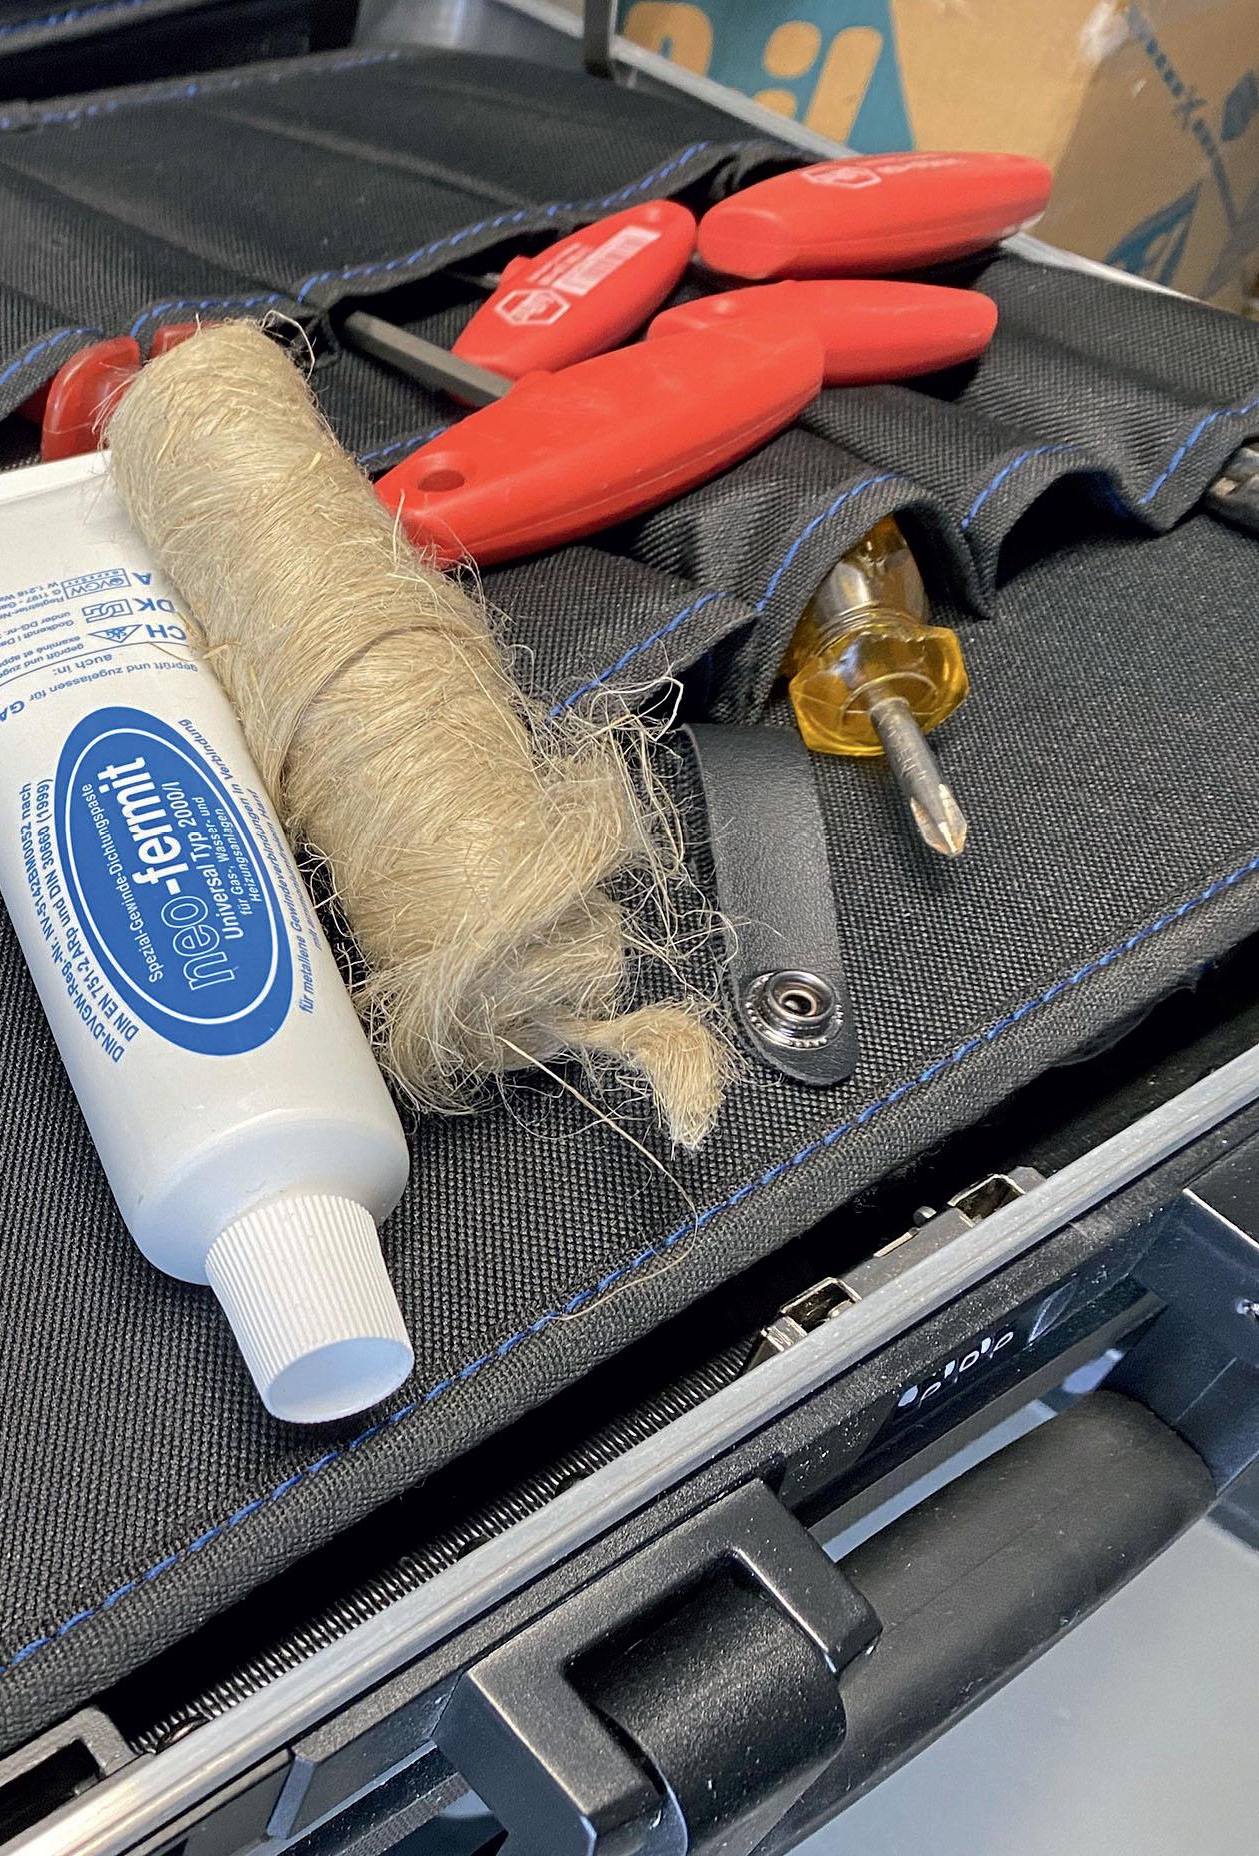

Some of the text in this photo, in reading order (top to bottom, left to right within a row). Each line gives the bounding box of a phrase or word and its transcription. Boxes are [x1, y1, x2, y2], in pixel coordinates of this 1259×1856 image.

[132, 598, 176, 613] DK
[40, 611, 71, 624] under
[22, 619, 75, 639] Godkendt
[145, 624, 188, 640] CH
[23, 656, 45, 669] und
[53, 653, 114, 676] auch in:
[126, 661, 152, 674] und
[153, 661, 199, 673] geprüft
[49, 667, 123, 693] zugelassen
[29, 689, 48, 702] für
[191, 796, 211, 817] und
[187, 831, 213, 863] Typ
[205, 819, 230, 863] Wasser-
[214, 808, 263, 902] Heizungsanlagen
[178, 718, 314, 1015] für metallene Gewindeverbindungen in Verbindung
[82, 783, 165, 983] Spezial-Gewinde-Dichtungspaste
[36, 778, 140, 1042] DIN EN 751-2 ARp und DIN 30660 (1999)
[196, 864, 244, 940] Universal
[237, 898, 253, 915] für
[18, 783, 126, 1063] DIN-DVGW-Reg.-Nr. NV-5142BM0052 nach
